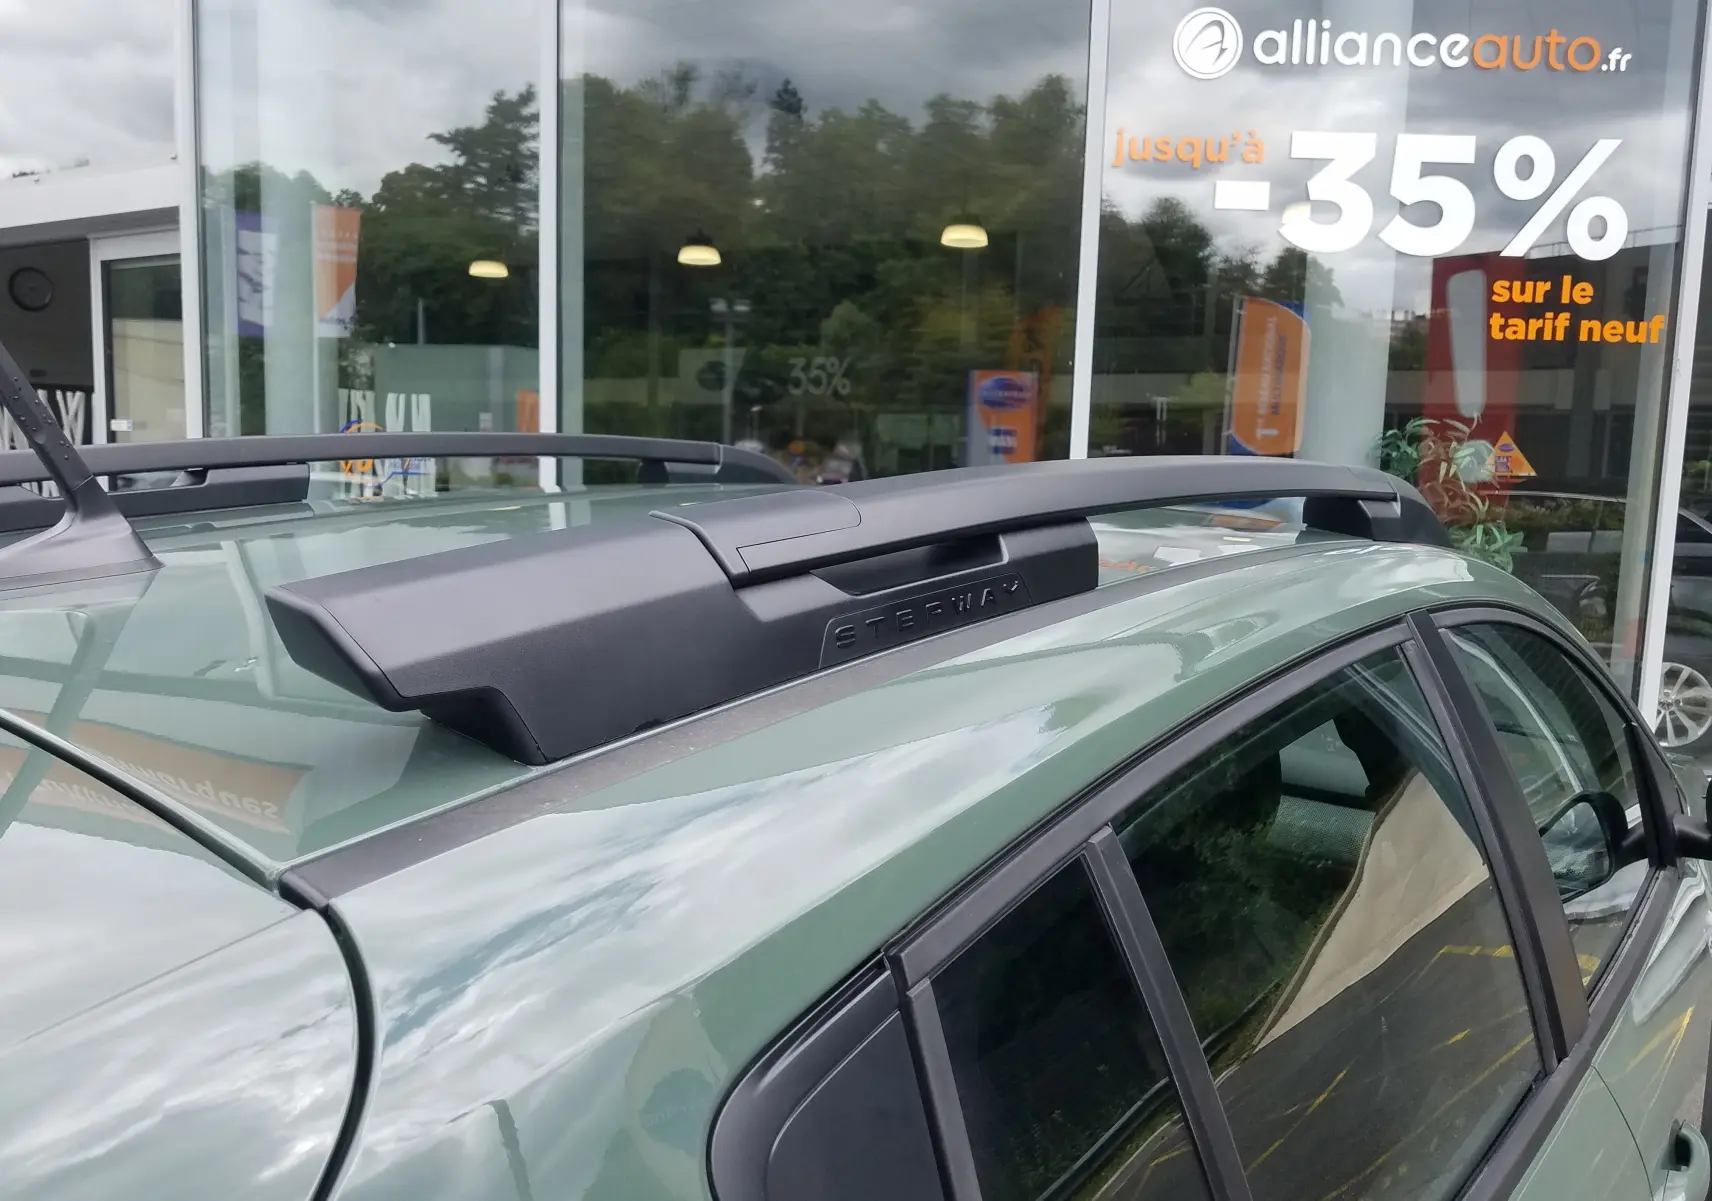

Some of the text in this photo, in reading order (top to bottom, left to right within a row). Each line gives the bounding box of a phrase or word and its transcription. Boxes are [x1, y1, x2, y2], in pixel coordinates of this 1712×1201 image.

[1253, 18, 1632, 72] allianceauto.fr
[1112, 127, 1265, 170] jusqu'à
[1214, 131, 1629, 261] -35%
[1491, 274, 1594, 305] sur le
[1489, 312, 1666, 344] tarif neuf
[835, 580, 1019, 649] STEPWAY
